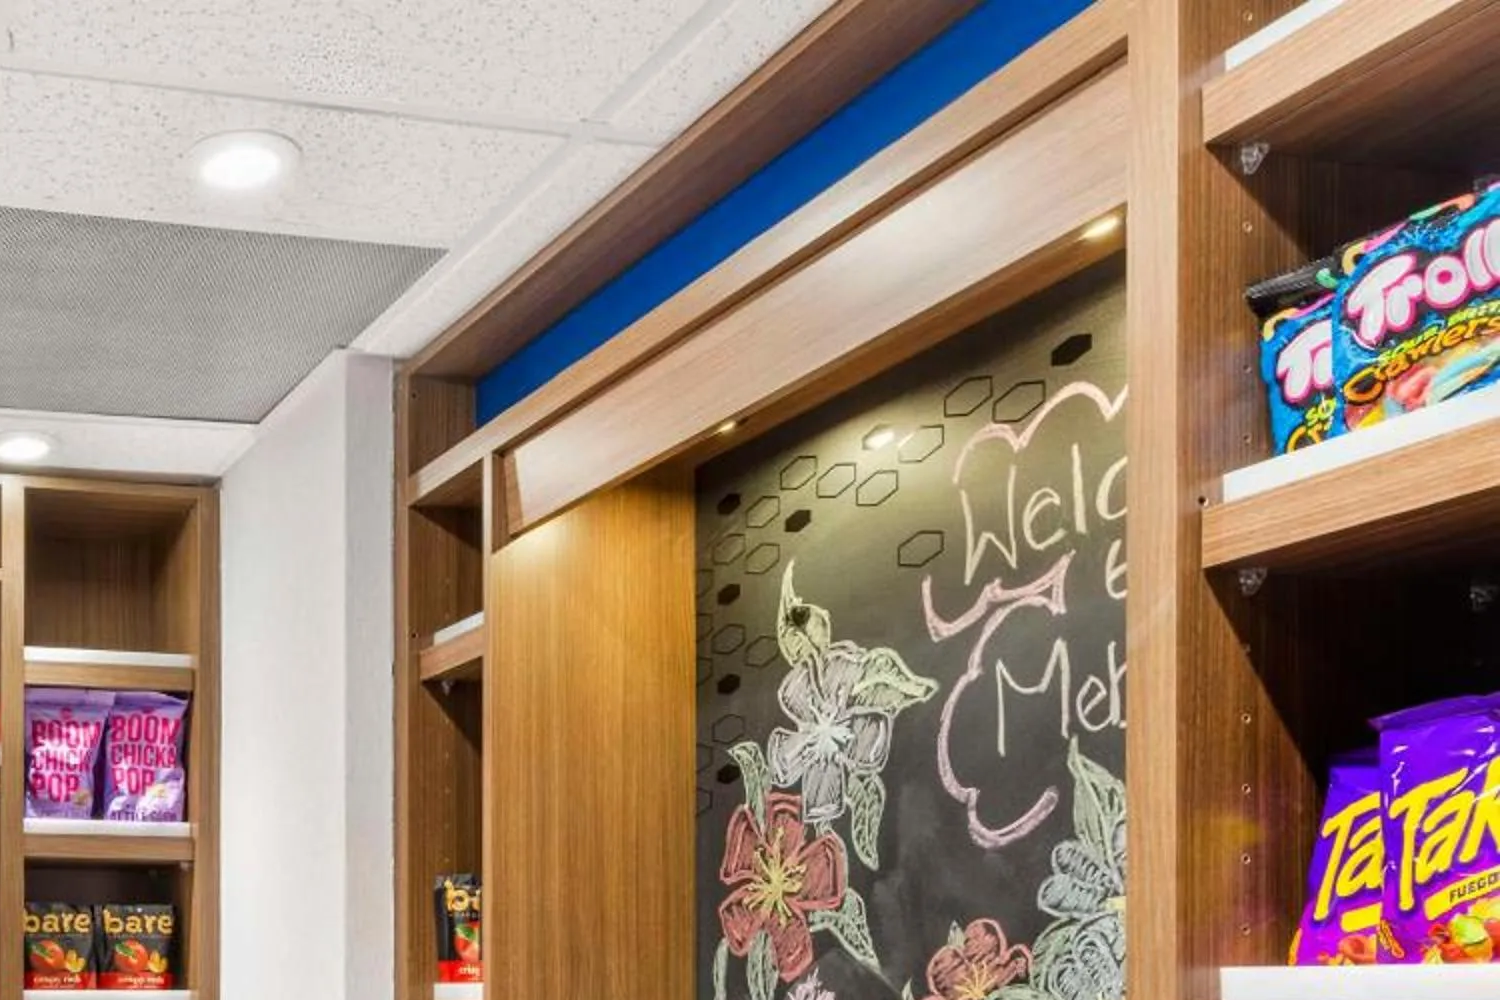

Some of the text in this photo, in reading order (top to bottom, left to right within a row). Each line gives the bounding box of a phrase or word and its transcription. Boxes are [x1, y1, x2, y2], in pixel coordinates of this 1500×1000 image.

[31, 718, 102, 750] BOOM
[110, 713, 181, 745] BOOM
[30, 748, 94, 774] CHICK
[30, 772, 80, 804] POP
[112, 766, 156, 797] POP
[24, 900, 91, 933] bare
[103, 908, 173, 934] bare
